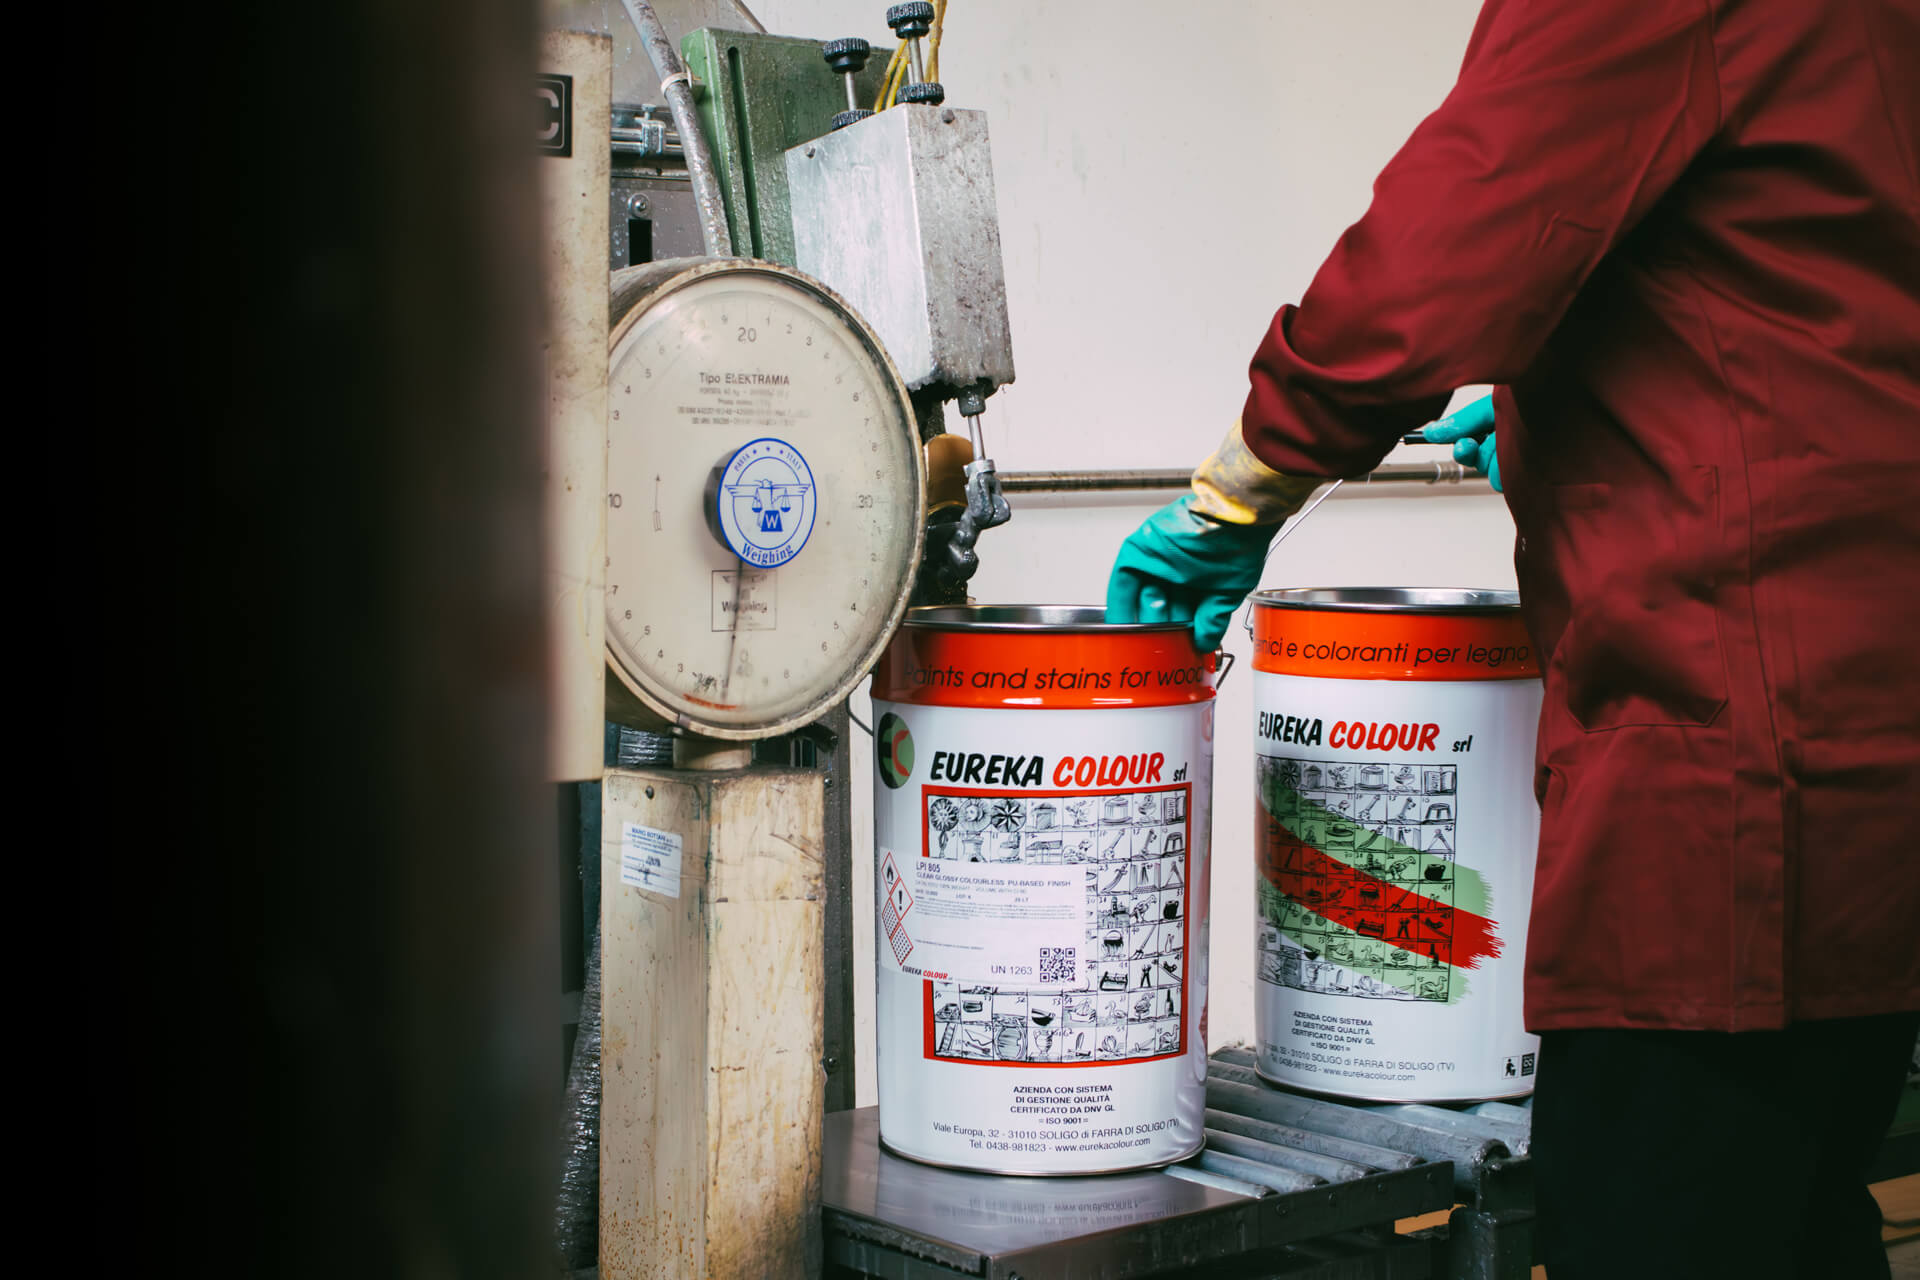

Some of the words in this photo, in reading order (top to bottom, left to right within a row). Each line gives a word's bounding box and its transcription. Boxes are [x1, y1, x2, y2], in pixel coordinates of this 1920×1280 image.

[737, 326, 757, 343] 20
[806, 335, 813, 347] 3
[699, 371, 722, 385] Tipo
[624, 384, 632, 395] 4
[853, 392, 860, 402] 6
[613, 409, 620, 421] 3
[608, 493, 623, 509] 10
[765, 513, 779, 530] W
[742, 543, 794, 566] Weighing
[612, 584, 619, 595] 7
[850, 602, 858, 612] 4
[624, 609, 633, 620] 6
[644, 624, 651, 636] 5
[821, 641, 829, 653] 6
[658, 649, 664, 660] 4
[1286, 642, 1298, 658] e
[1303, 641, 1409, 664] coloranti
[1414, 650, 1459, 668] per
[1465, 642, 1529, 668] legno
[677, 662, 684, 674] 3
[904, 664, 964, 688] Paints
[971, 667, 1028, 689] and
[1034, 667, 1112, 689] stains
[1119, 666, 1151, 689] for
[1258, 710, 1323, 747] EUREKA
[1329, 720, 1440, 752] COLOUR
[1451, 734, 1473, 753] srl
[930, 751, 1044, 788] EUREKA
[1052, 752, 1165, 788] COLOUR
[1173, 761, 1188, 782] srl
[928, 862, 941, 873] 805
[916, 871, 934, 881] CLEAR
[935, 874, 959, 884] GLOSSY
[960, 876, 1005, 886] COLOURLESS
[1047, 880, 1071, 888] FINISH
[902, 965, 922, 976] EUREKA
[922, 969, 949, 980] COLOUR
[990, 964, 1006, 975] UN
[1010, 966, 1033, 976] 1263
[1292, 1011, 1321, 1020] AZIENDA
[1339, 1017, 1374, 1026] SISTEMA
[1294, 1019, 1302, 1027] DI
[1302, 1021, 1336, 1032] GESTIONE
[1291, 1028, 1333, 1040] CERTIFICATO
[1311, 1053, 1343, 1065] SOLIGO
[1344, 1058, 1352, 1066] di
[1353, 1059, 1385, 1068] FARRA
[1386, 1061, 1396, 1069] DI
[1398, 1062, 1435, 1070] SOLIGO
[1436, 1062, 1456, 1071] (TV)
[1323, 1067, 1416, 1080] www.eurekacolour.com
[1013, 1085, 1052, 1094] AZIENDA
[1054, 1086, 1074, 1094] CON
[1075, 1084, 1113, 1094] SISTEMA
[1015, 1095, 1025, 1104] DI
[1026, 1096, 1072, 1105] GESTIONE
[1010, 1105, 1068, 1115] CERTIFICATO
[1070, 1106, 1082, 1114] DA
[1083, 1104, 1102, 1113] DNV
[1104, 1104, 1116, 1112] GL
[1045, 1117, 1061, 1125] ISO
[1062, 1116, 1081, 1125] 9001
[932, 1121, 952, 1133] Viale
[953, 1124, 986, 1138] Europa,
[987, 1128, 1000, 1138] 32
[1008, 1129, 1038, 1139] 31010
[1039, 1130, 1079, 1140] SOLIGO
[1081, 1130, 1089, 1139] di
[1091, 1126, 1123, 1138] FARRA
[1124, 1126, 1135, 1136] DI
[1135, 1120, 1166, 1135] SOLIGO
[968, 1139, 983, 1149] Tel.
[985, 1141, 1047, 1153] 0438-981823
[1055, 1136, 1151, 1153] www.eurekacolour.com
